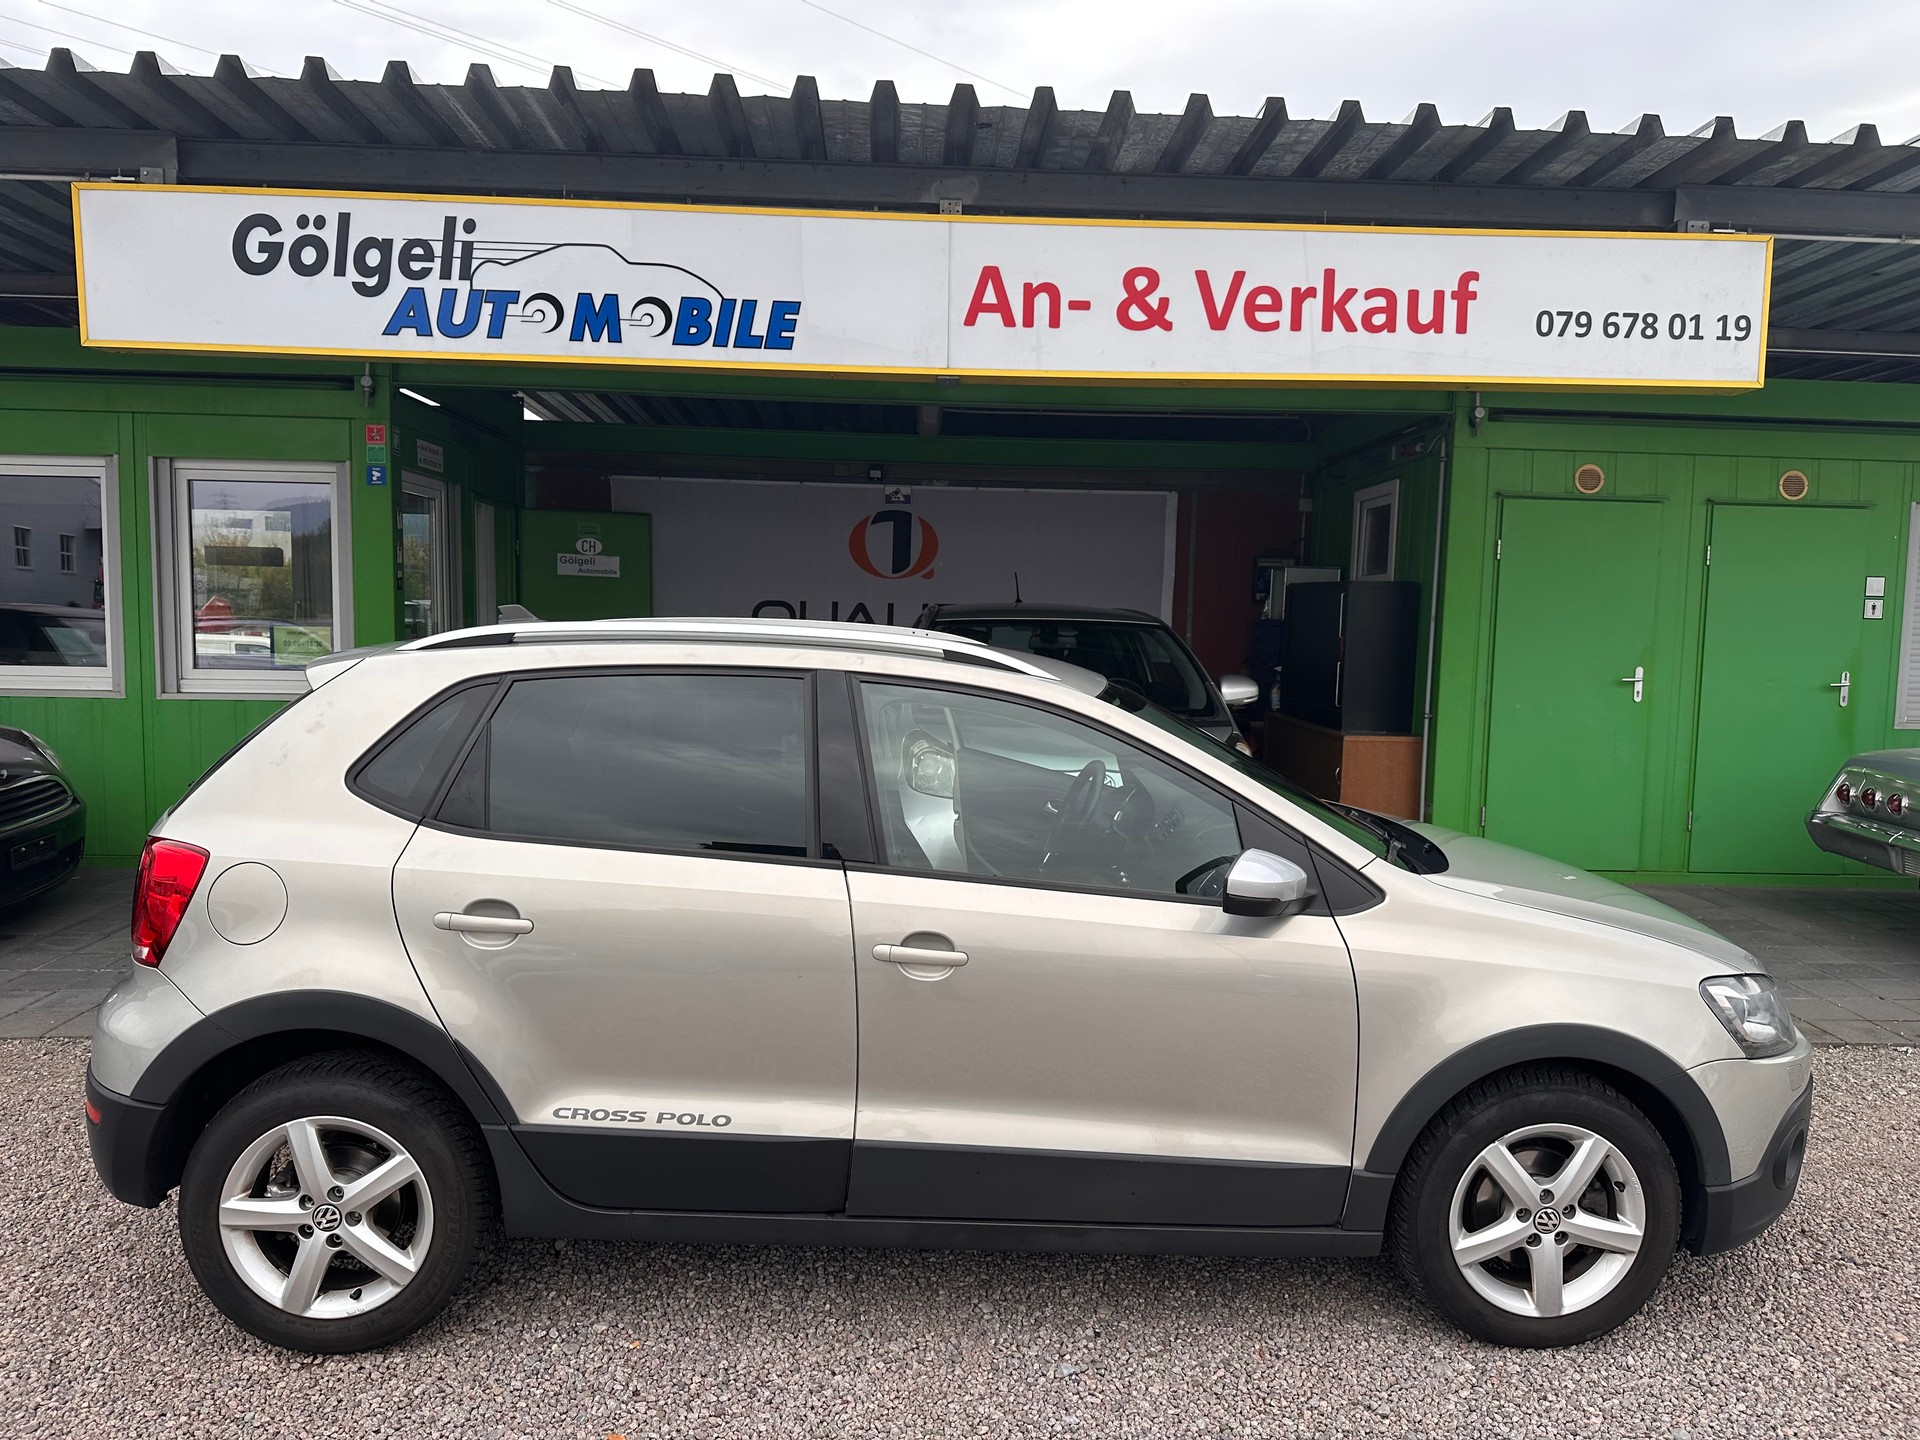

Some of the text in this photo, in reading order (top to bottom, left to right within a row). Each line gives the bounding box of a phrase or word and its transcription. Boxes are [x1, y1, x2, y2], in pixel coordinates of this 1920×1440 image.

[232, 211, 476, 298] Gölgeli
[963, 265, 1480, 335] An- & Verkauf
[1535, 310, 1752, 342] 079 678 01 19
[581, 540, 596, 553] CH
[559, 555, 596, 567] Gölgeli
[578, 567, 618, 576] Automobile
[552, 1107, 732, 1128] CROSS POLO
